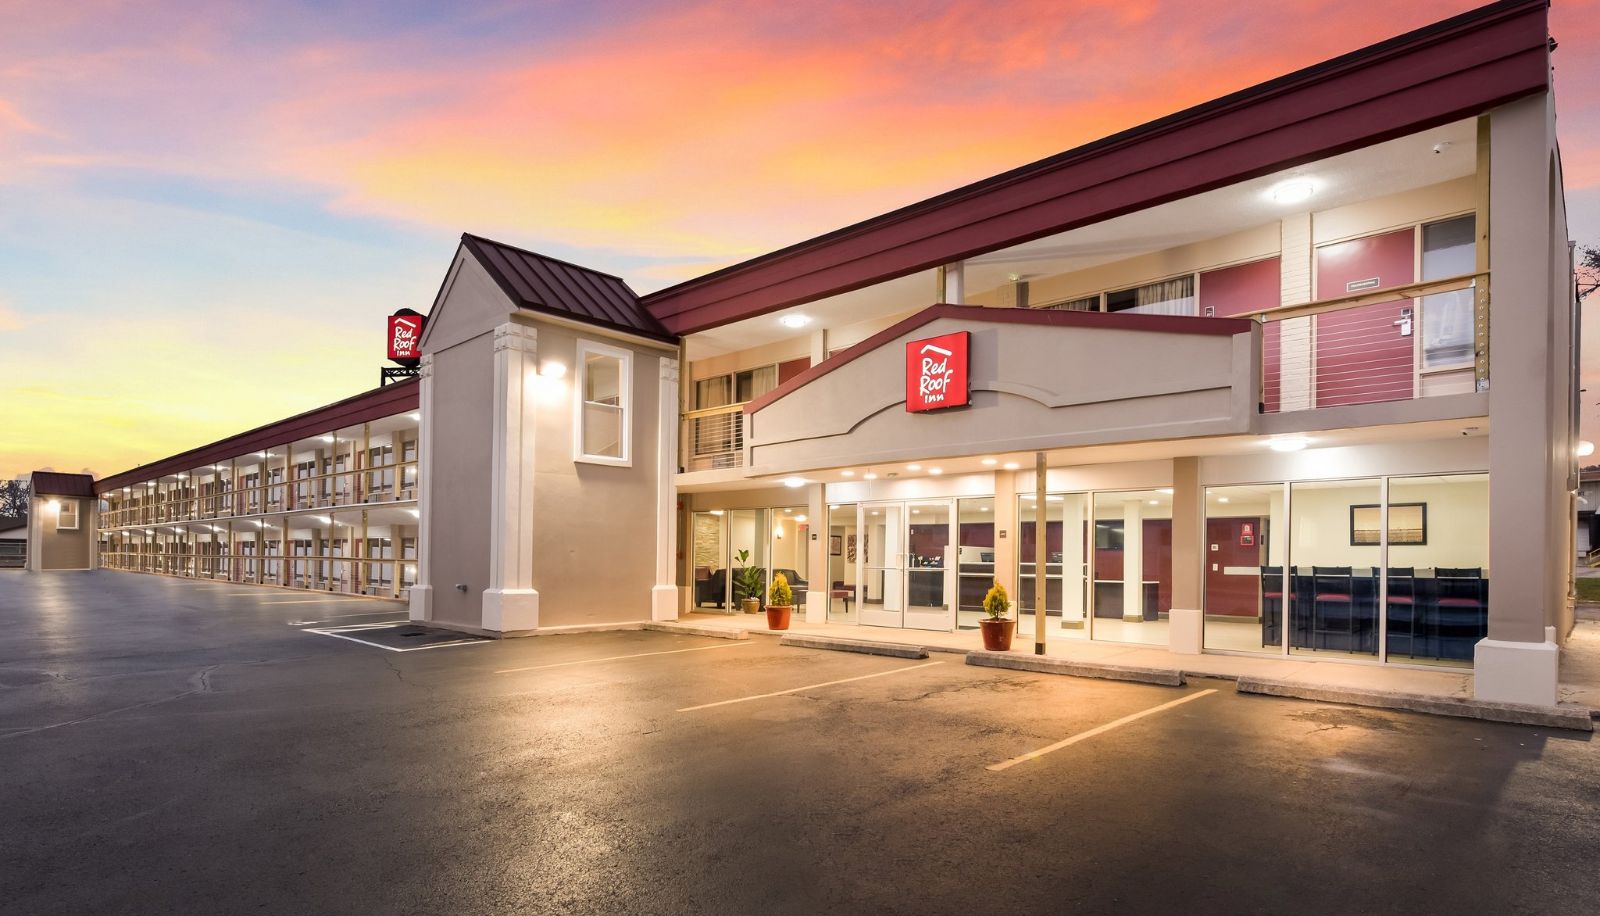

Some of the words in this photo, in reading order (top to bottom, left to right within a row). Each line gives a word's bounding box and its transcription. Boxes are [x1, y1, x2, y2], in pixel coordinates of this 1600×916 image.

[395, 326, 413, 339] Red
[393, 336, 417, 352] Roof
[923, 358, 947, 376] Red
[920, 370, 953, 396] Roof
